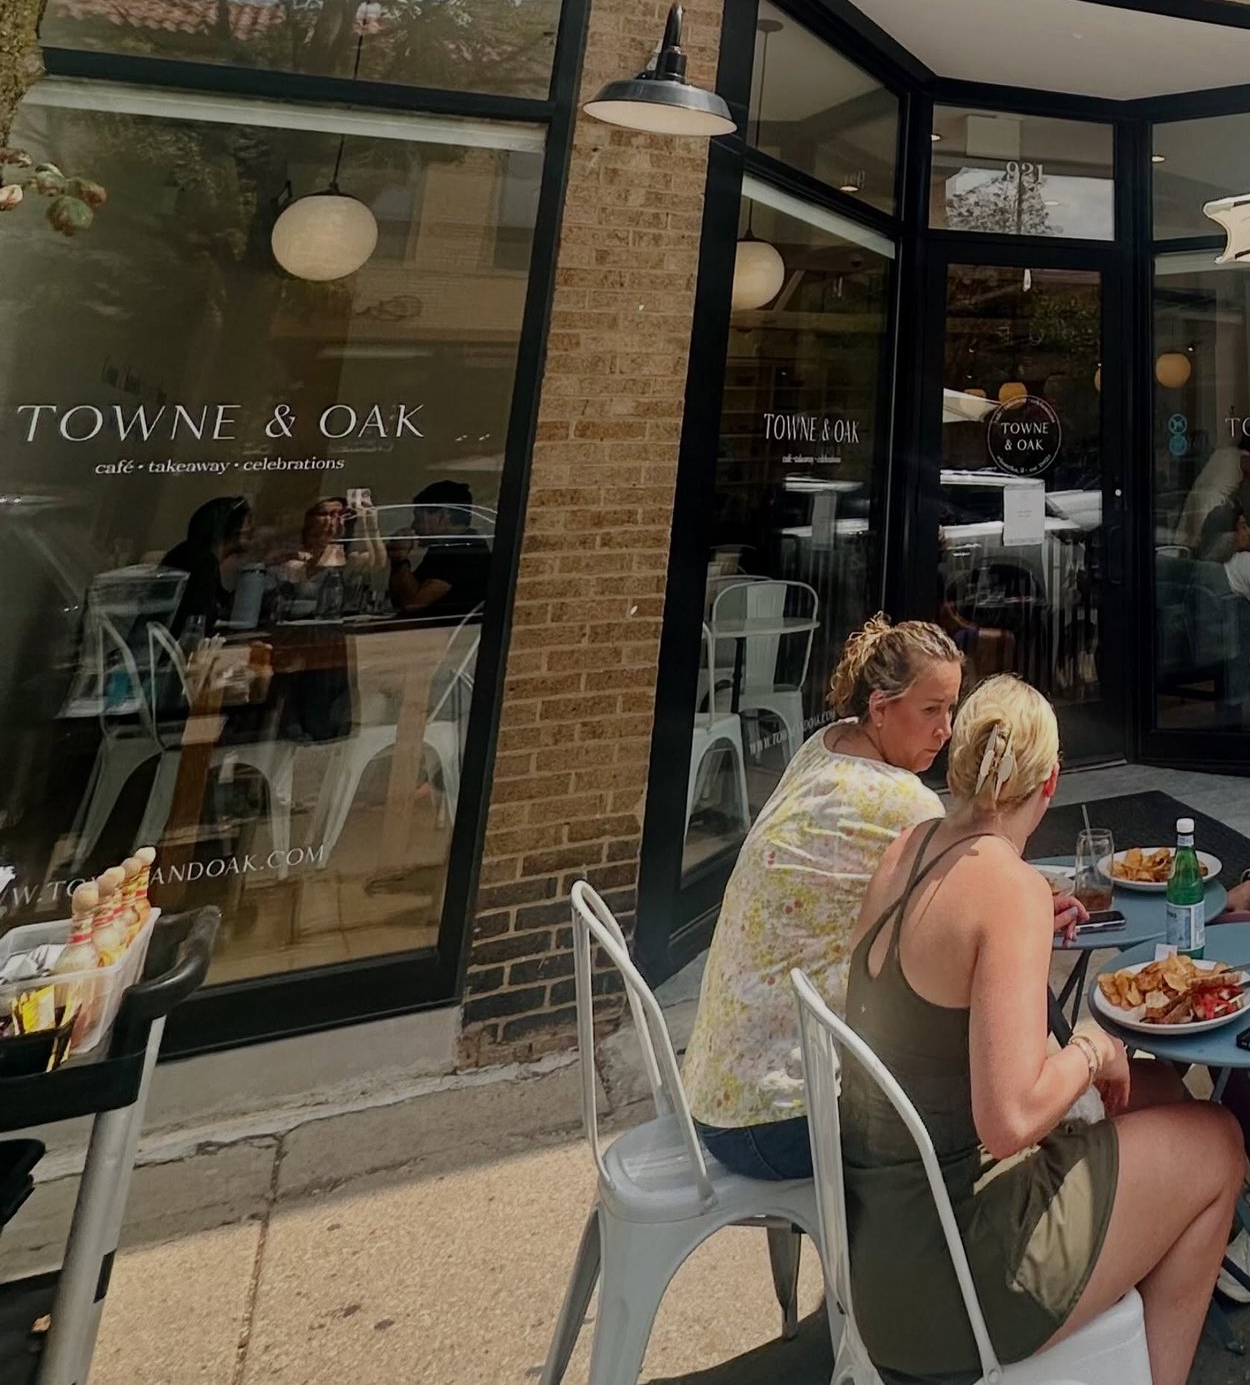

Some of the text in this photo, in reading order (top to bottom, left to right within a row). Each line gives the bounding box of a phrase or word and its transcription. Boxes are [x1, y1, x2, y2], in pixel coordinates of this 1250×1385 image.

[1006, 161, 1043, 185] 921
[17, 403, 424, 443] TOWNE & OAK
[763, 413, 860, 444] TOWNE & OAK
[1000, 422, 1049, 435] TOWNE
[1004, 438, 1044, 452] & OAK
[95, 456, 345, 475] café takeaway celebrations
